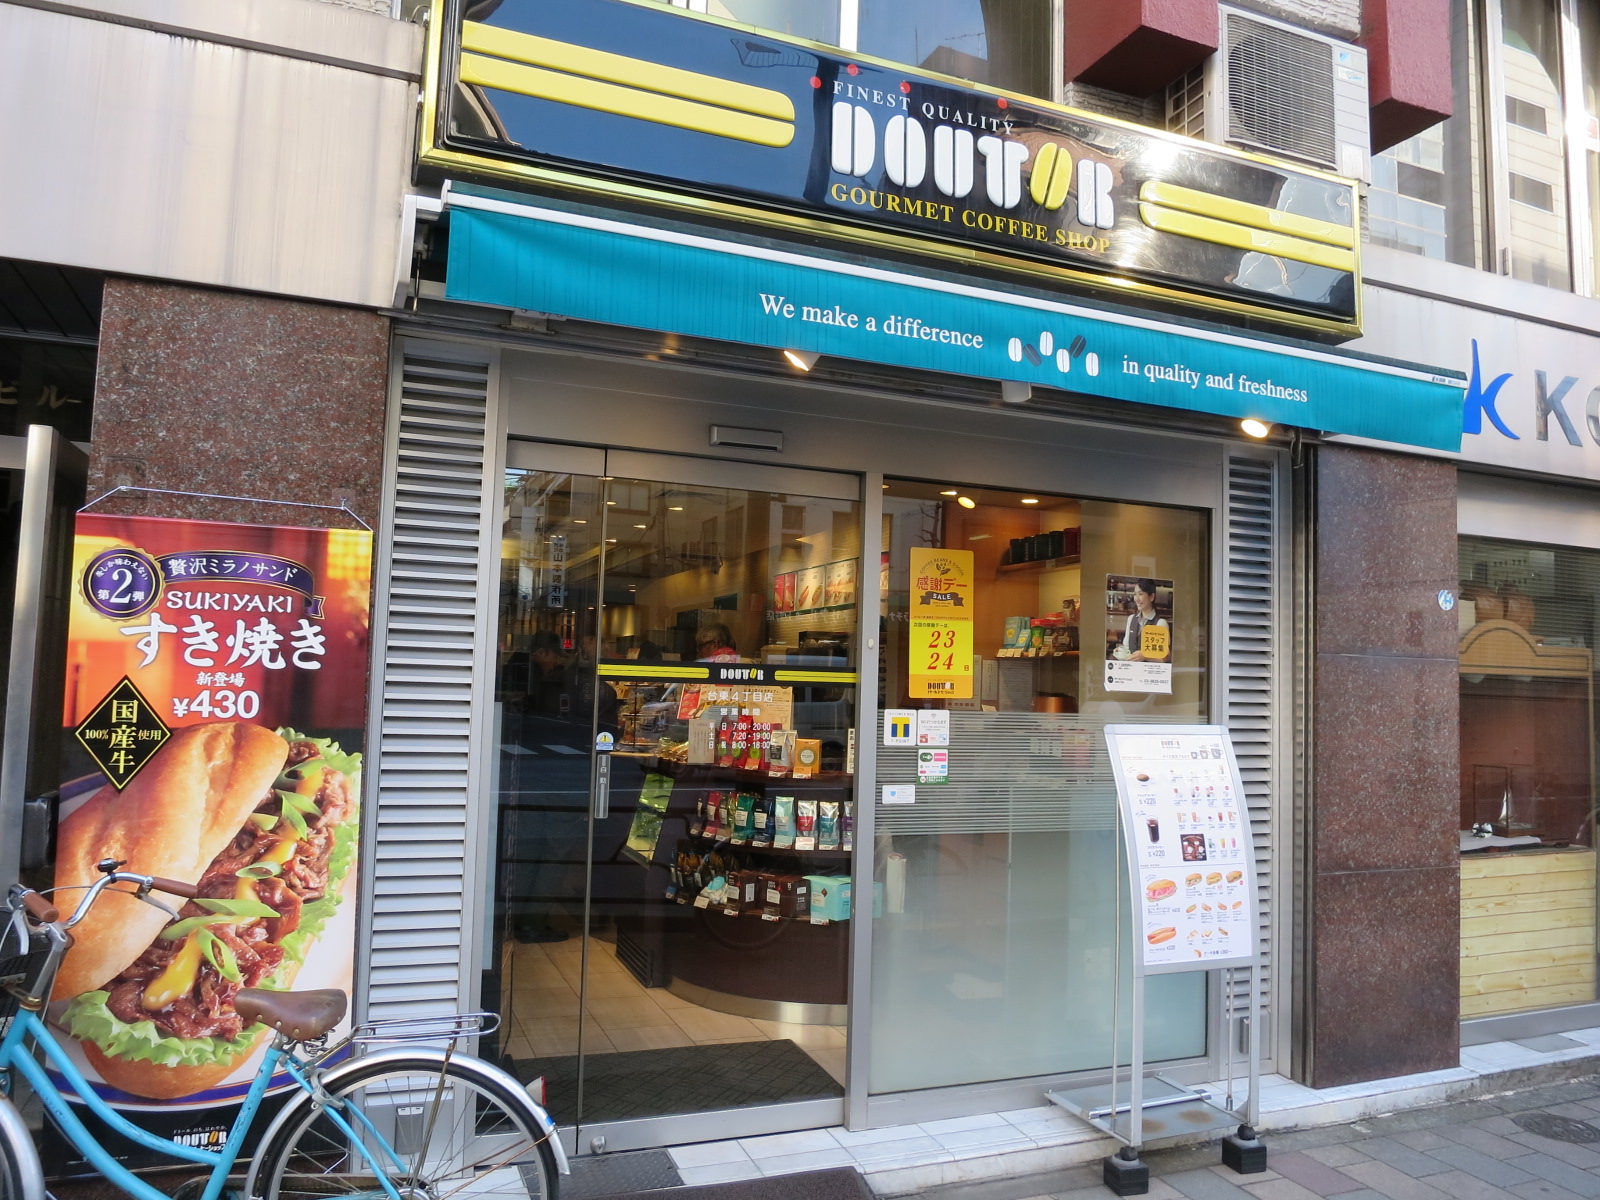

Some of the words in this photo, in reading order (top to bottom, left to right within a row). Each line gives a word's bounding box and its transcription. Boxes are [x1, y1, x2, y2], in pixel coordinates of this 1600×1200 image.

[833, 80, 911, 110] FINEST
[922, 102, 1014, 135] QUALITY
[831, 101, 1115, 229] DOUTOR
[831, 183, 954, 223] GOURMET
[962, 210, 1048, 241] COFFEE
[1055, 229, 1111, 253] SHOP
[759, 293, 795, 318] We
[801, 306, 859, 328] make
[865, 317, 877, 332] a
[883, 315, 984, 349] difference
[1122, 355, 1140, 375] in
[1144, 363, 1201, 389] quality
[1205, 373, 1234, 390] and
[1238, 375, 1308, 403] freshness
[168, 557, 298, 582] 贅沢ミラノサンド
[916, 576, 968, 591] 感謝デー
[166, 590, 293, 613] SUKIYAKI
[120, 612, 327, 670] すき焼き
[928, 630, 956, 648] 23
[927, 652, 954, 670] 24
[196, 672, 246, 688] 新登場
[720, 668, 764, 681] DOUTOR
[172, 690, 260, 719] ¥430
[720, 708, 761, 716] 営業時間
[84, 729, 109, 740] 100%
[138, 729, 162, 741] 使用
[109, 698, 139, 774] 国産牛
[173, 1131, 227, 1146] DOUTOR
